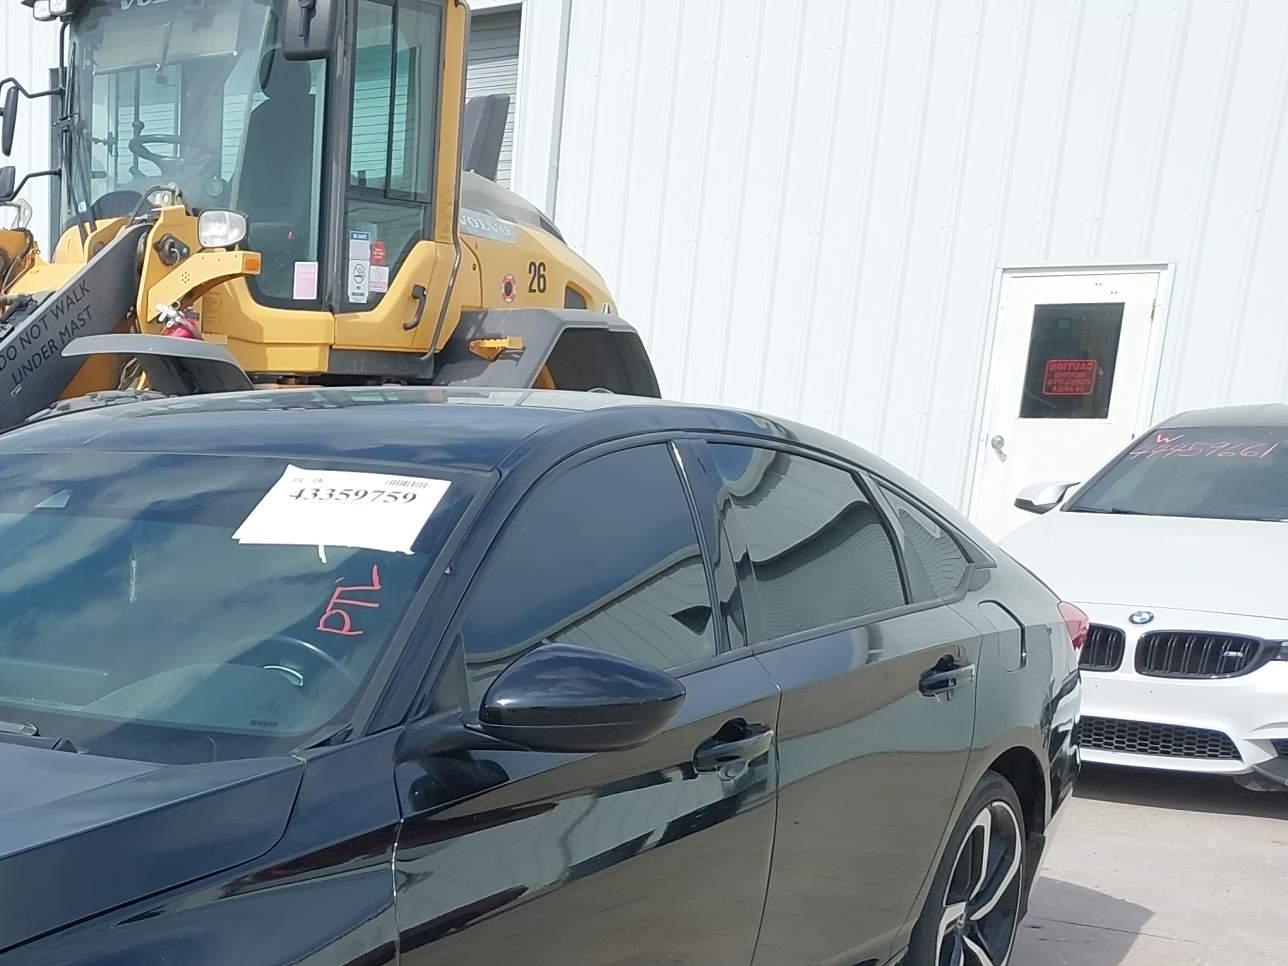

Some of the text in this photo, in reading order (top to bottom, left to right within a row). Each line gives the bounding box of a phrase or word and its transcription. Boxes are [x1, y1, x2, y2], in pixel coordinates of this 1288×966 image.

[460, 215, 511, 236] VOLVO
[528, 261, 547, 294] 26
[19, 314, 50, 350] NOT
[50, 279, 91, 320] WALK
[11, 304, 92, 385] UNDER MAST
[289, 487, 417, 504] 43359759
[316, 564, 382, 636] PTL
